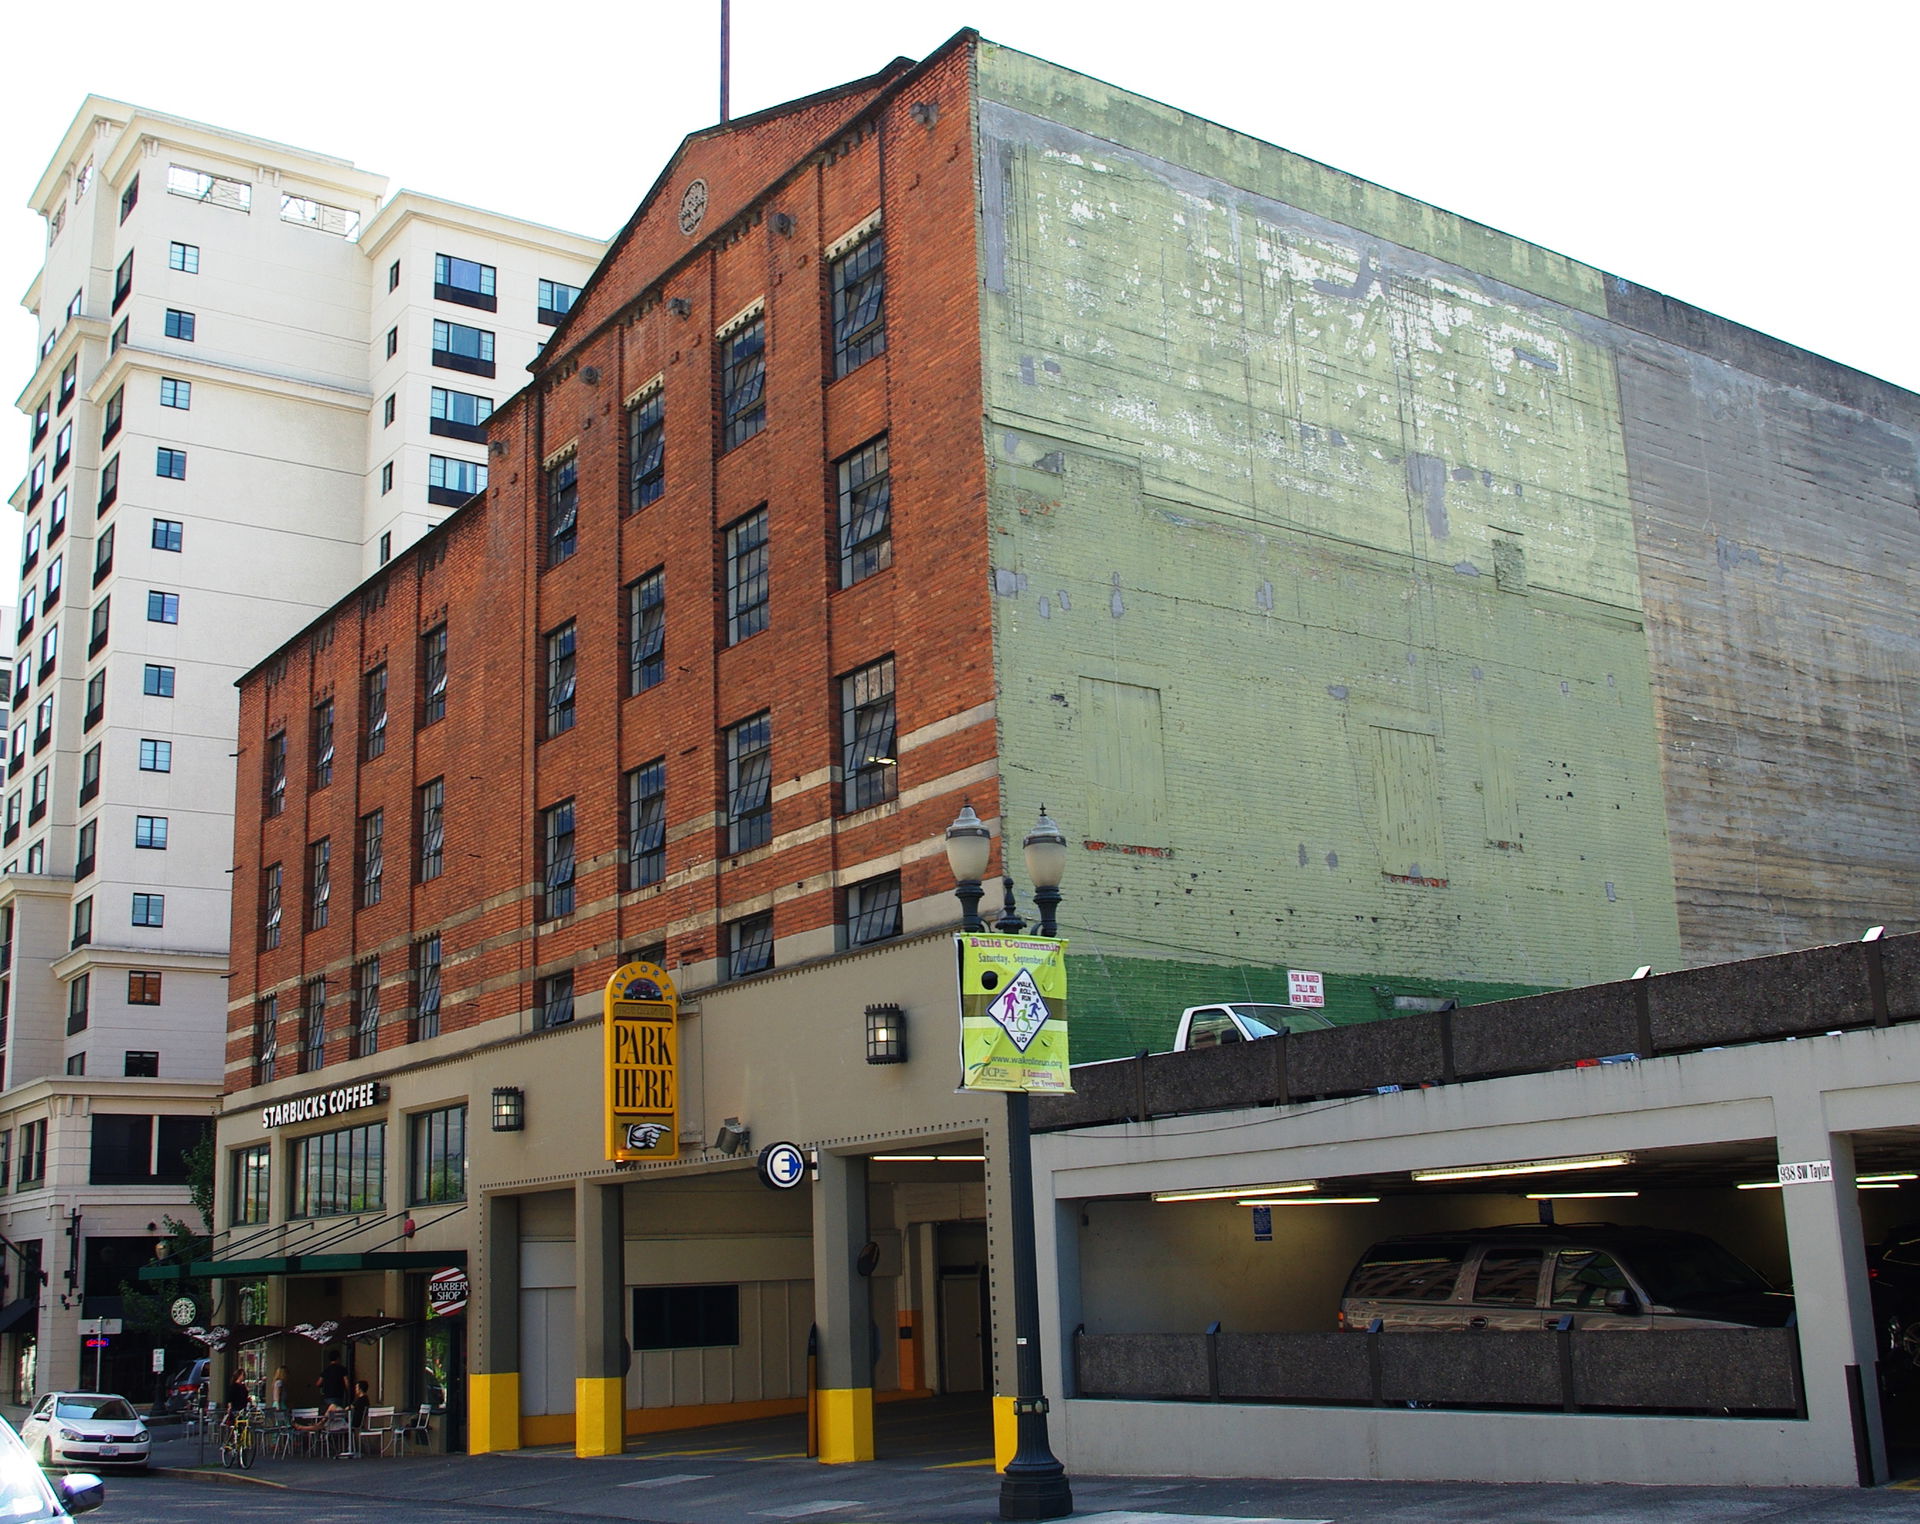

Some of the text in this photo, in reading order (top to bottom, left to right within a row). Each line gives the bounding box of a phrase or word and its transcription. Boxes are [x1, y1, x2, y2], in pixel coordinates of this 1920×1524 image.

[971, 937, 1061, 953] Build Community
[614, 1025, 673, 1066] PARK
[981, 1066, 1000, 1077] UCP
[614, 1069, 673, 1108] HERE
[262, 1082, 375, 1129] STARBUCKS COFFEE
[1780, 1163, 1830, 1181] 938 SW Taylor
[432, 1281, 466, 1300] BARBER SHOP
